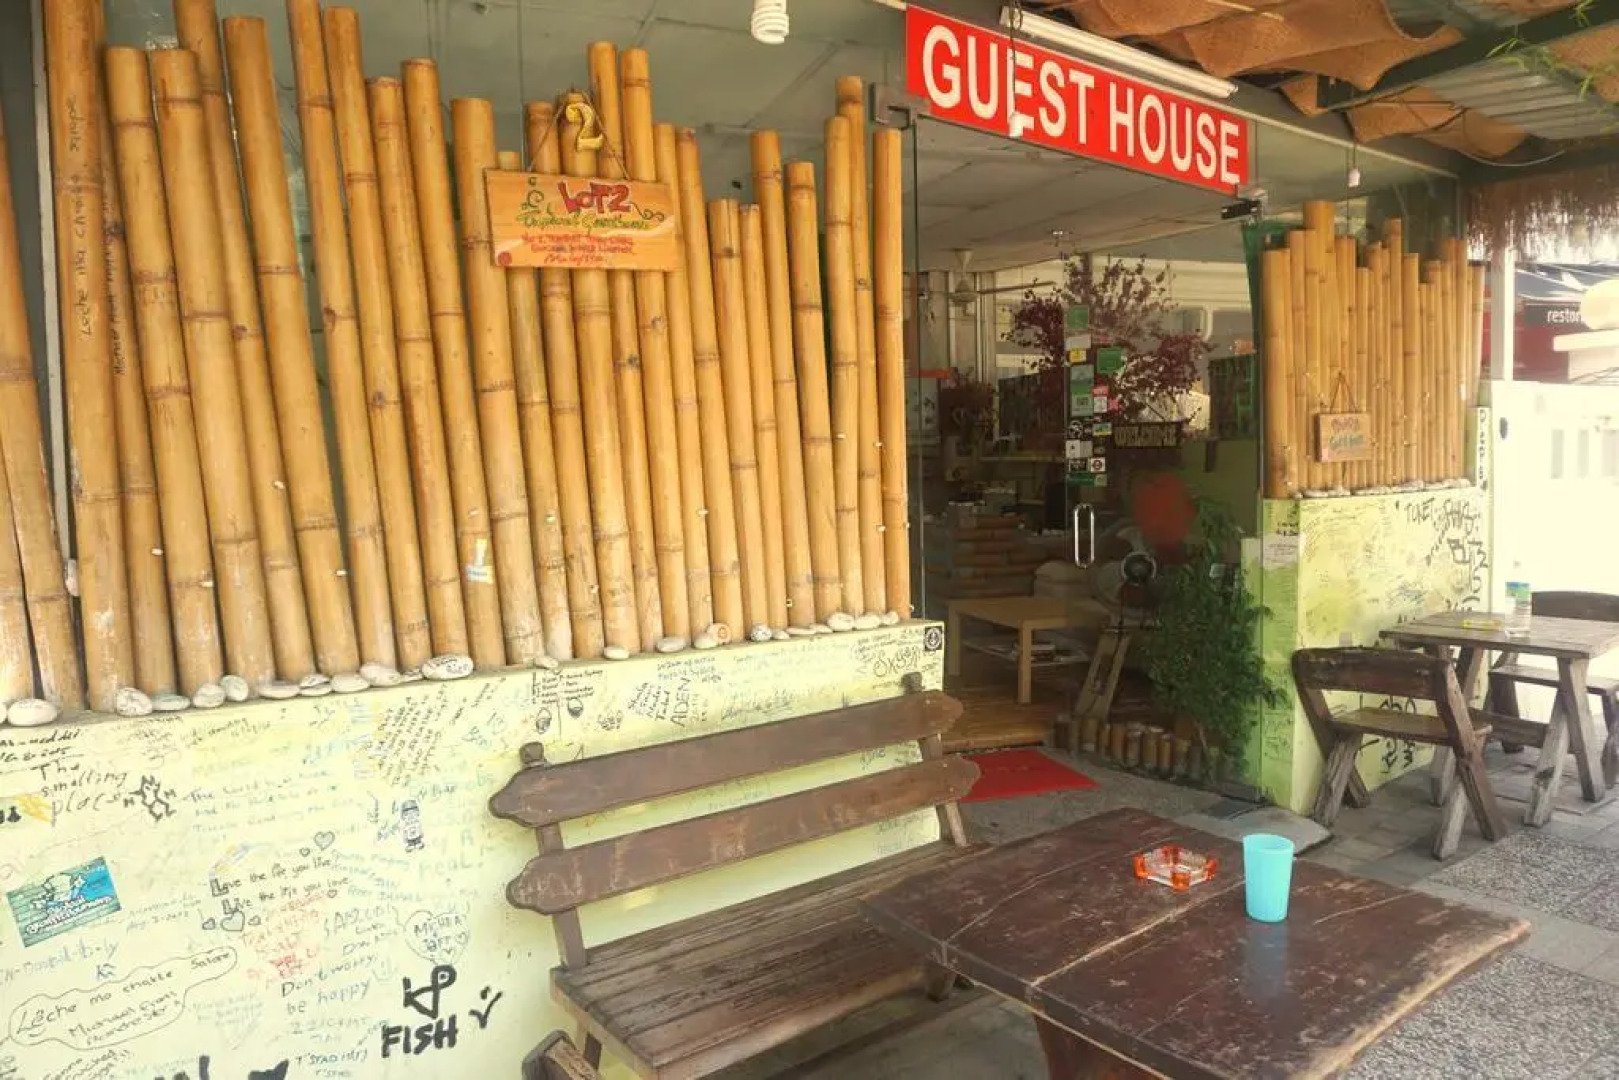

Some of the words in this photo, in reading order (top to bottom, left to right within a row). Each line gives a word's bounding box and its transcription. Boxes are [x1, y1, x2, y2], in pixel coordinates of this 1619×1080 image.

[922, 25, 1094, 145] GUEST
[1109, 82, 1240, 184] HOUSE
[381, 1014, 457, 1058] FISH
